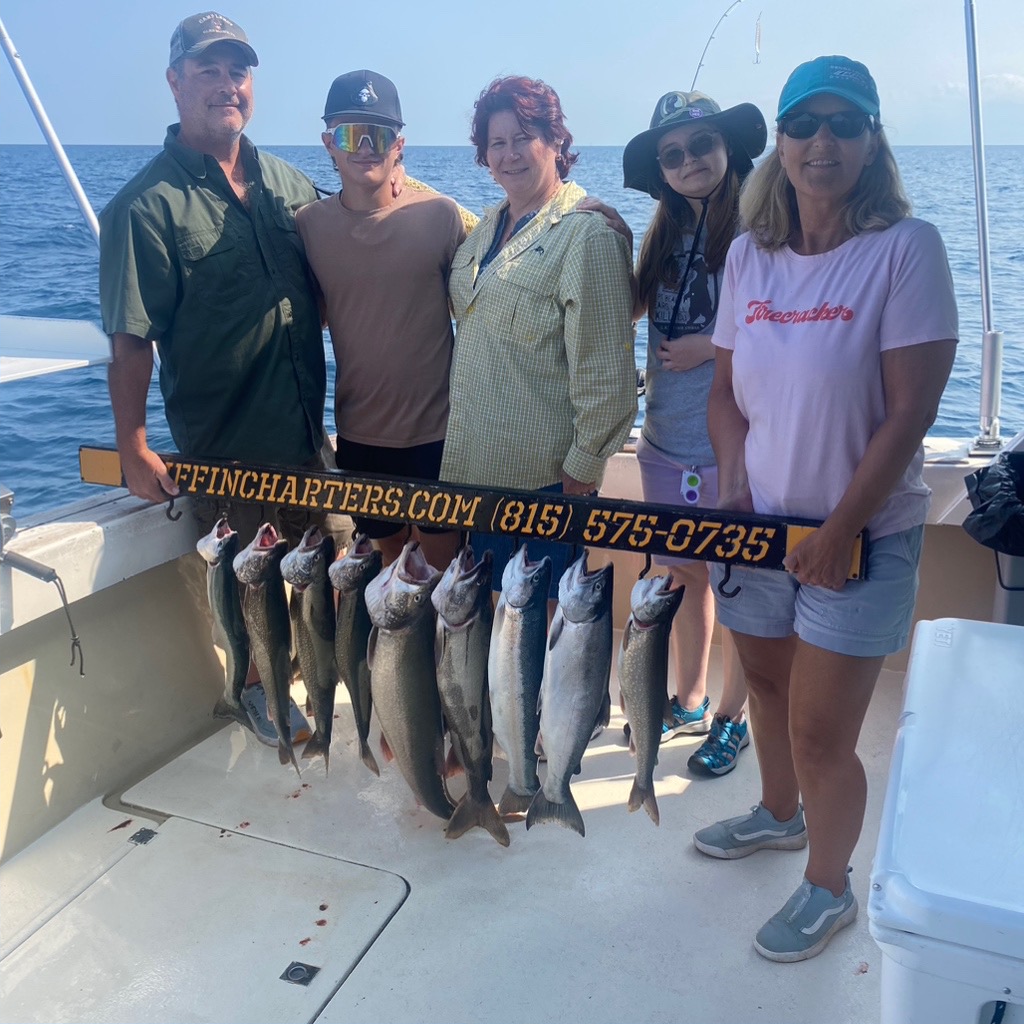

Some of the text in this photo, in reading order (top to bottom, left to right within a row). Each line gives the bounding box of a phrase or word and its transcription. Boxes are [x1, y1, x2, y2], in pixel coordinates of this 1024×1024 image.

[166, 462, 777, 563] FFINCHARTERS.COM (815) 575-0735
